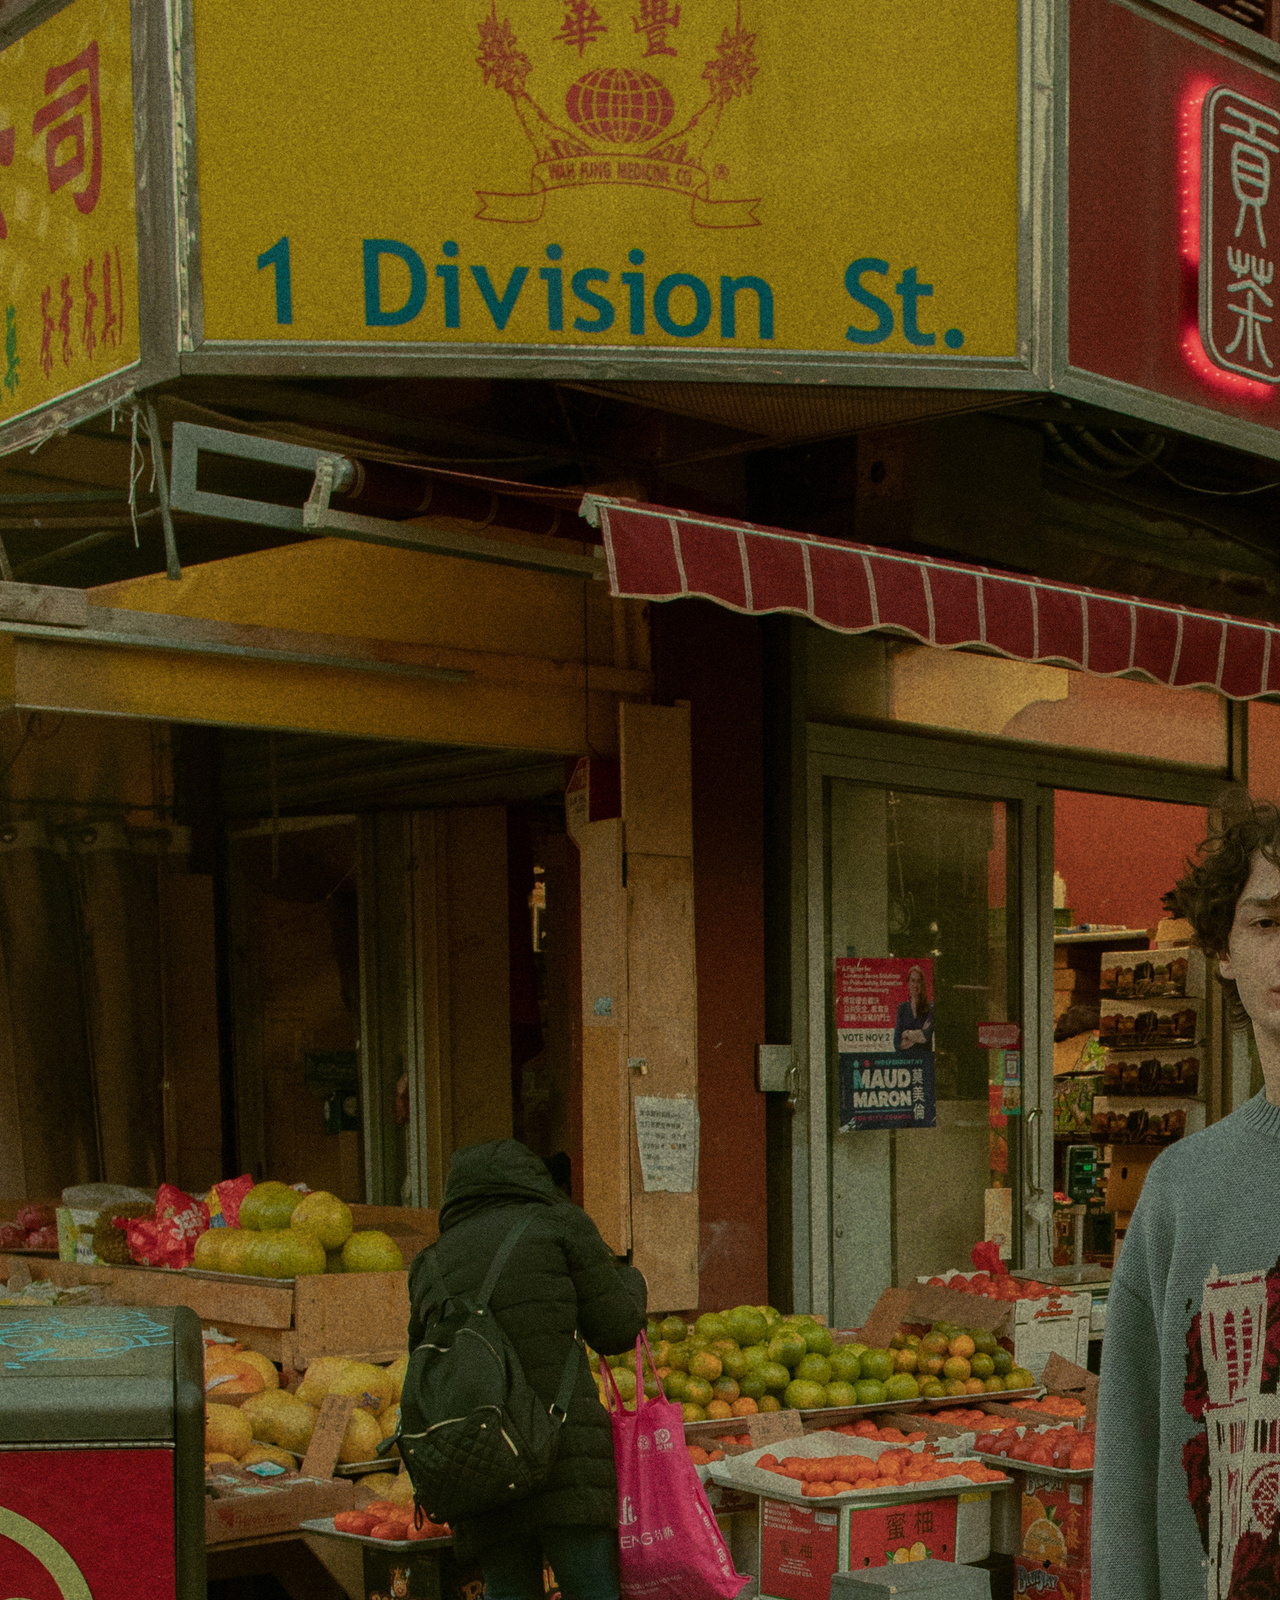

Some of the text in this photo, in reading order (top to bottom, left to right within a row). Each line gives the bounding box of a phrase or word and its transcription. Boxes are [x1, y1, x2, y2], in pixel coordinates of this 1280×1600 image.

[257, 237, 964, 349] 1 Division St.
[842, 1033, 891, 1042] VOTE NOV 2
[853, 1069, 911, 1089] MAUD
[853, 1090, 912, 1108] MARON
[886, 1510, 934, 1541] 蜜柚
